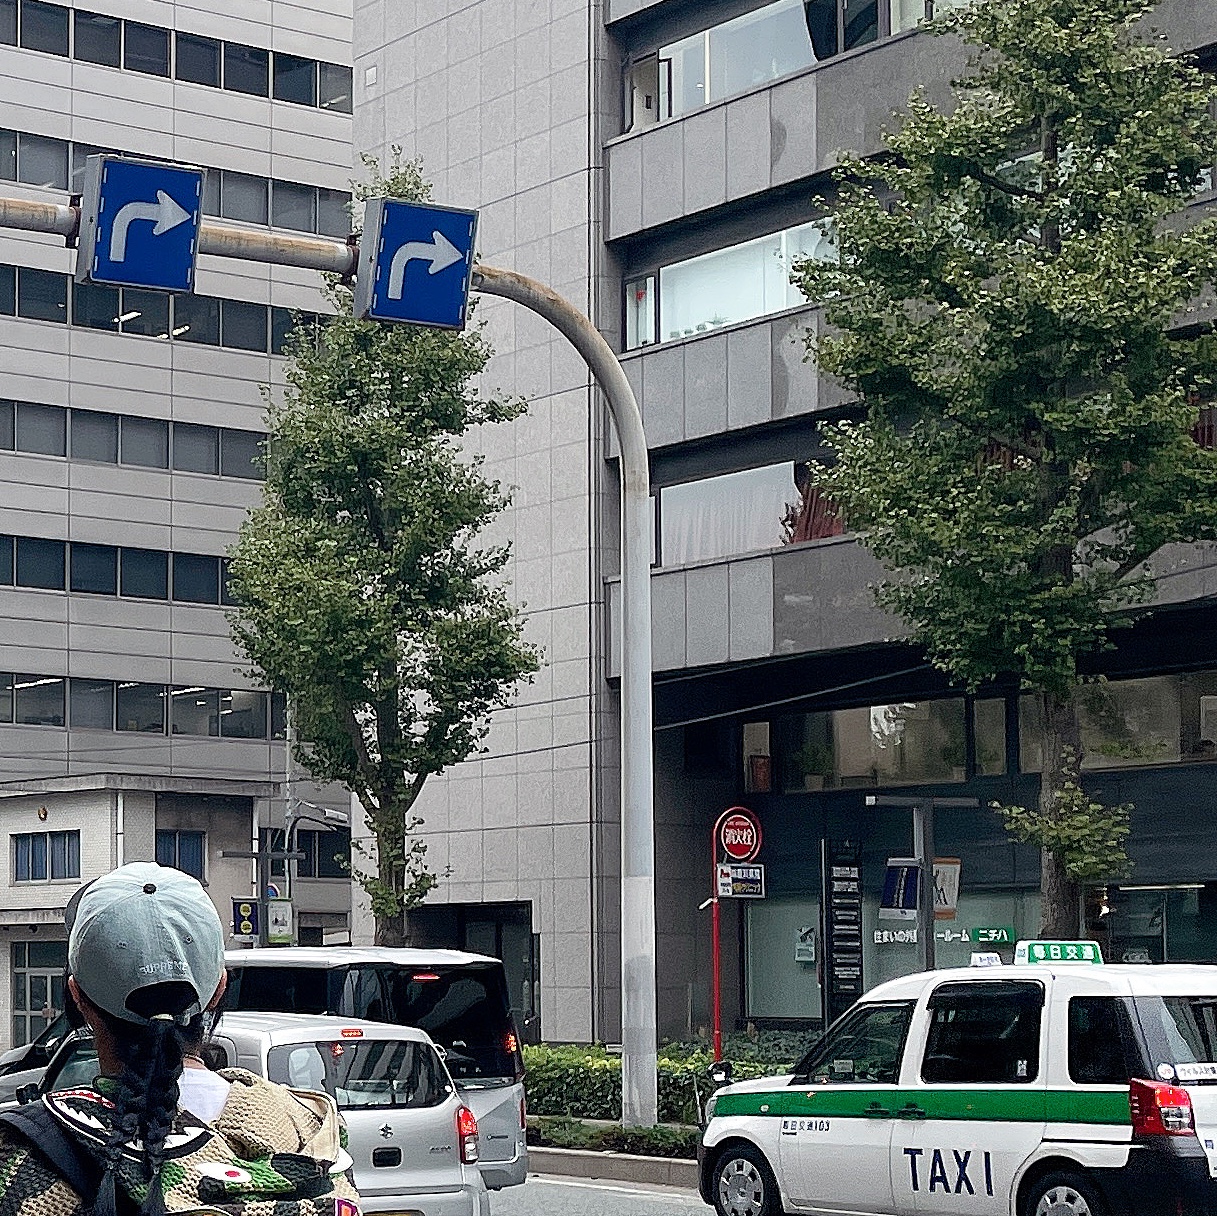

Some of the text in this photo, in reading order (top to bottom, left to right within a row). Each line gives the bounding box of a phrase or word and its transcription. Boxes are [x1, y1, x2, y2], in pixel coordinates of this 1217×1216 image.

[978, 929, 1008, 942] ニチハ
[903, 1147, 994, 1197] TAXI
